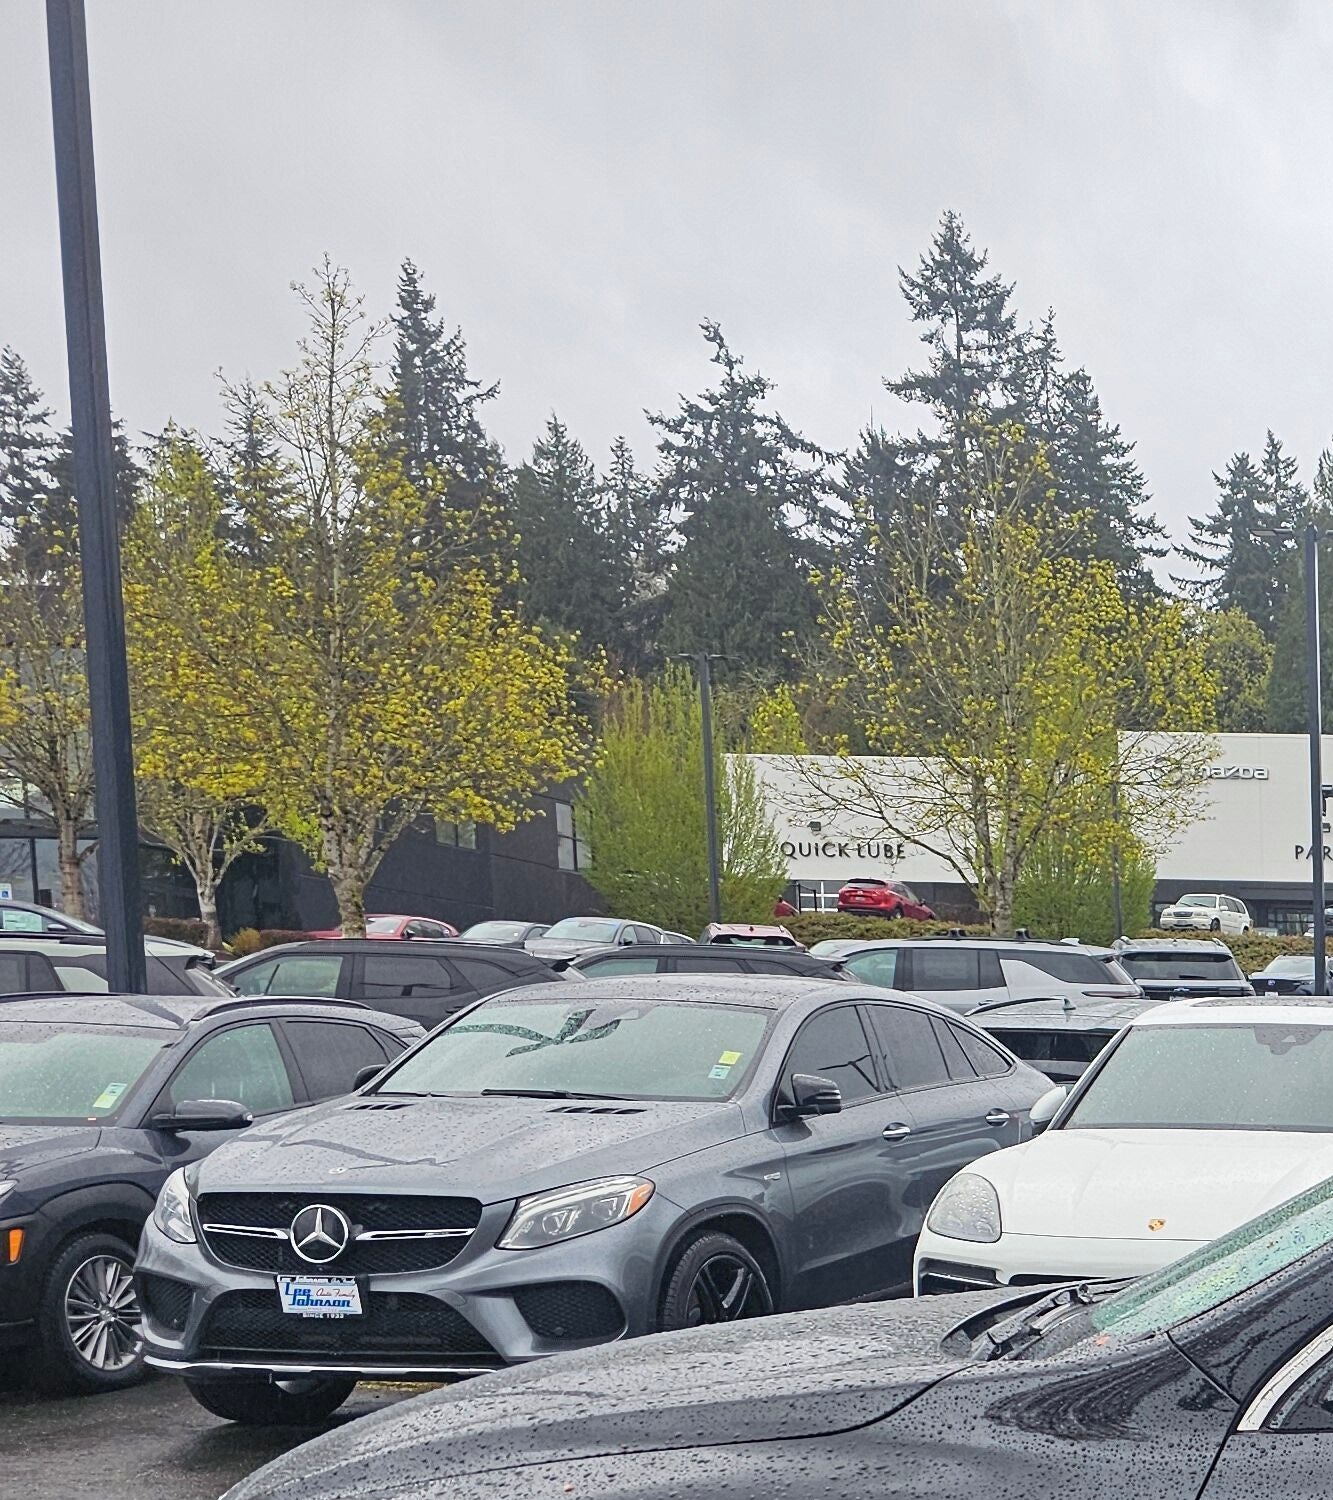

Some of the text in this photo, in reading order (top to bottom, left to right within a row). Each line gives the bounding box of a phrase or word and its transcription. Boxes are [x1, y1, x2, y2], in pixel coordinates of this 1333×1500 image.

[780, 842, 906, 860] QUICK LUBE
[285, 1282, 314, 1297] Lee
[288, 1294, 352, 1308] Johnson
